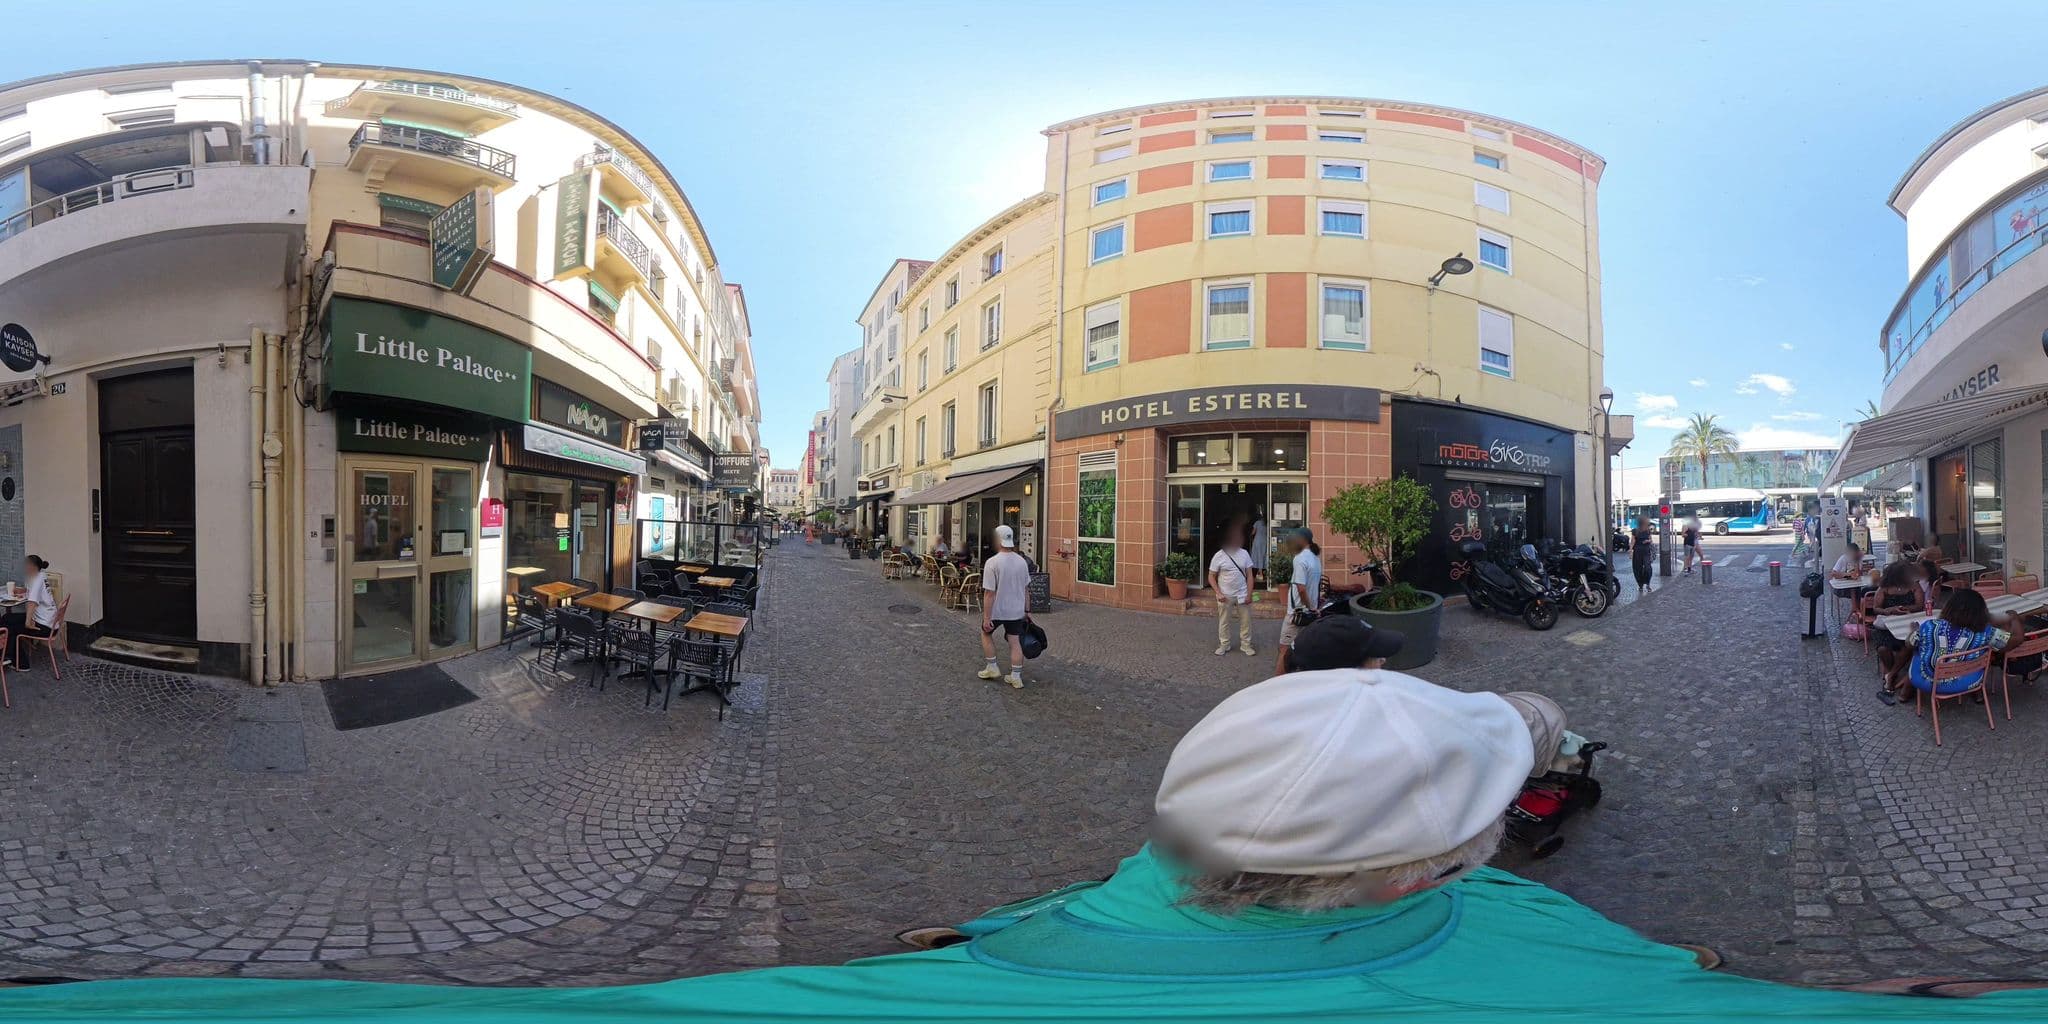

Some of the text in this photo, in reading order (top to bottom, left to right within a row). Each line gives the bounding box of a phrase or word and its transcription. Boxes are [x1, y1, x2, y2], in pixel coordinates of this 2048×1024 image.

[433, 193, 475, 227] HOTEL
[434, 216, 475, 250] Palace
[436, 207, 471, 237] Little
[3, 331, 35, 350] MAISON
[4, 341, 35, 358] KAYSER
[355, 332, 504, 383] Little Palace
[52, 384, 64, 394] 20
[1101, 392, 1308, 425] HOTEL ESTEREL
[355, 418, 467, 446] Little Palace
[714, 456, 750, 466] COIFFURE
[1440, 459, 1495, 469] LOCATION
[360, 494, 409, 506] HOTEL
